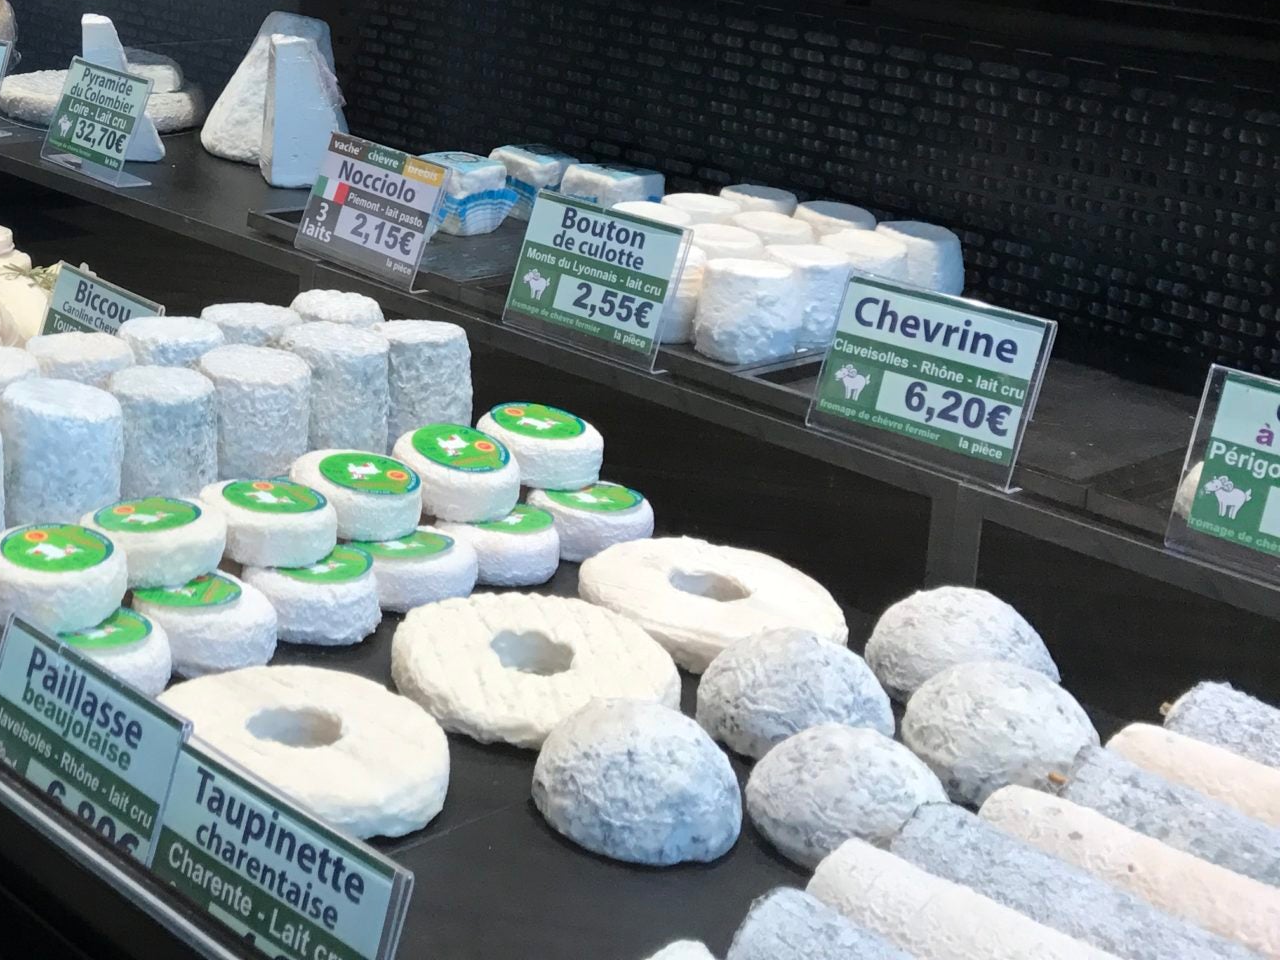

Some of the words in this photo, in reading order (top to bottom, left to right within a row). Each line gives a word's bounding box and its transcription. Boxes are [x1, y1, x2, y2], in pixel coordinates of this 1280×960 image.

[70, 83, 83, 98] du
[84, 86, 135, 115] Colombier
[81, 66, 133, 97] Pyramide
[68, 98, 89, 117] Loire
[94, 107, 113, 125] Lait
[112, 116, 127, 130] cru
[75, 119, 127, 154] 32,70€
[334, 139, 360, 156] vache
[338, 159, 416, 204] Nocciolo
[301, 217, 333, 243] laits
[315, 202, 329, 222] 3
[349, 212, 417, 256] 2,15€
[385, 205, 399, 220] lait
[398, 212, 424, 230] pasto.
[560, 206, 646, 250] Bouton
[526, 246, 557, 266] Monts
[558, 256, 572, 269] du
[572, 258, 618, 284] Lyonnais
[625, 275, 642, 291] lait
[643, 283, 662, 297] cru
[552, 229, 576, 251] de
[578, 239, 645, 271] culotte
[62, 300, 94, 325] Caroline
[74, 279, 132, 325] Biccou
[572, 281, 655, 330] 2,55€
[613, 329, 623, 341] la
[854, 296, 1019, 364] Chevrine
[833, 337, 909, 369] Claveisolles
[920, 360, 965, 385] Rhône
[975, 375, 998, 394] lait
[1002, 383, 1025, 401] cru
[820, 397, 856, 418] fromage
[858, 407, 870, 420] de
[905, 421, 941, 441] fermier
[904, 380, 1013, 437] 6,20€
[958, 436, 970, 450] la
[971, 439, 1003, 460] pièce
[1255, 422, 1275, 447] à
[1188, 516, 1235, 538] fromage
[1237, 531, 1253, 544] de
[26, 645, 143, 751] Paillasse
[21, 679, 131, 772] beaujolaise
[60, 752, 99, 792] Rhône
[108, 784, 131, 817] lait
[130, 803, 154, 830] cru
[194, 765, 366, 906] Taupinette
[168, 841, 253, 918] Charente
[269, 907, 311, 955] Lait
[194, 821, 339, 932] charentaise
